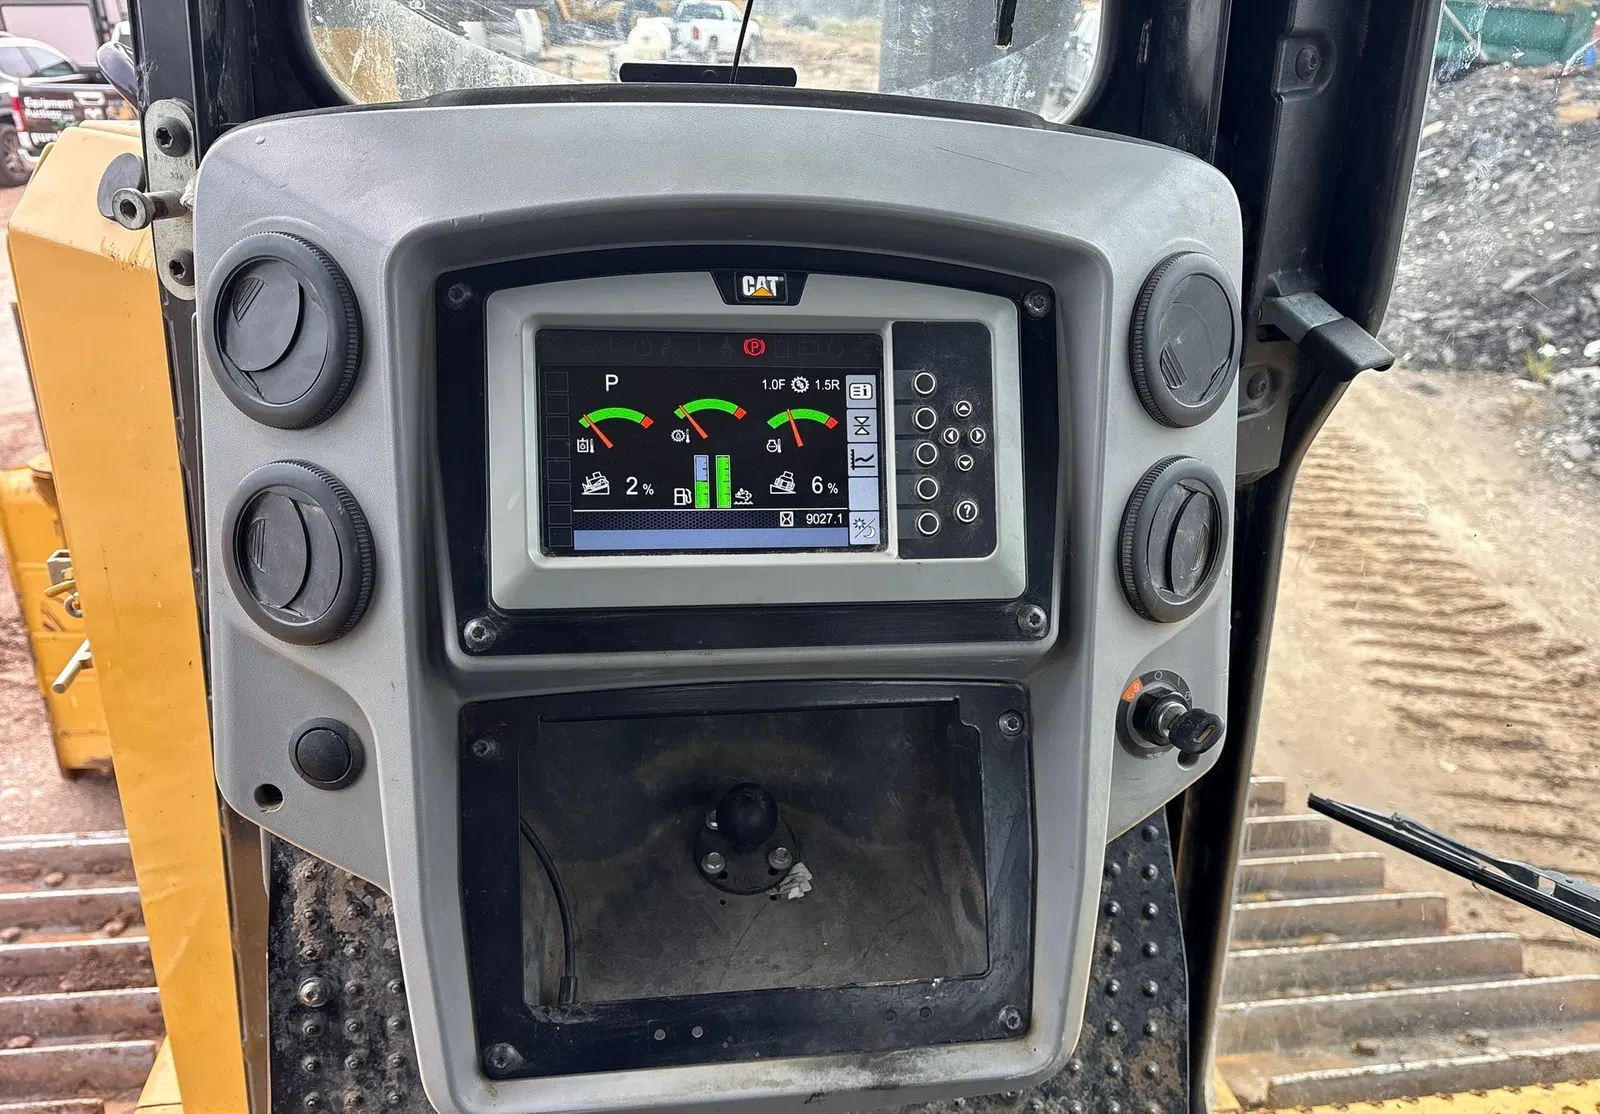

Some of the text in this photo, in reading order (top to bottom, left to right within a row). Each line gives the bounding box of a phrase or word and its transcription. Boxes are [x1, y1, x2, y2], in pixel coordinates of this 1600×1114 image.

[742, 275, 779, 297] CAT
[605, 374, 619, 392] P
[761, 378, 786, 391] 1.0F
[814, 378, 840, 391] 1.5R
[625, 476, 654, 496] 2 %
[811, 475, 839, 495] 6 %
[805, 512, 844, 525] 9027.1
